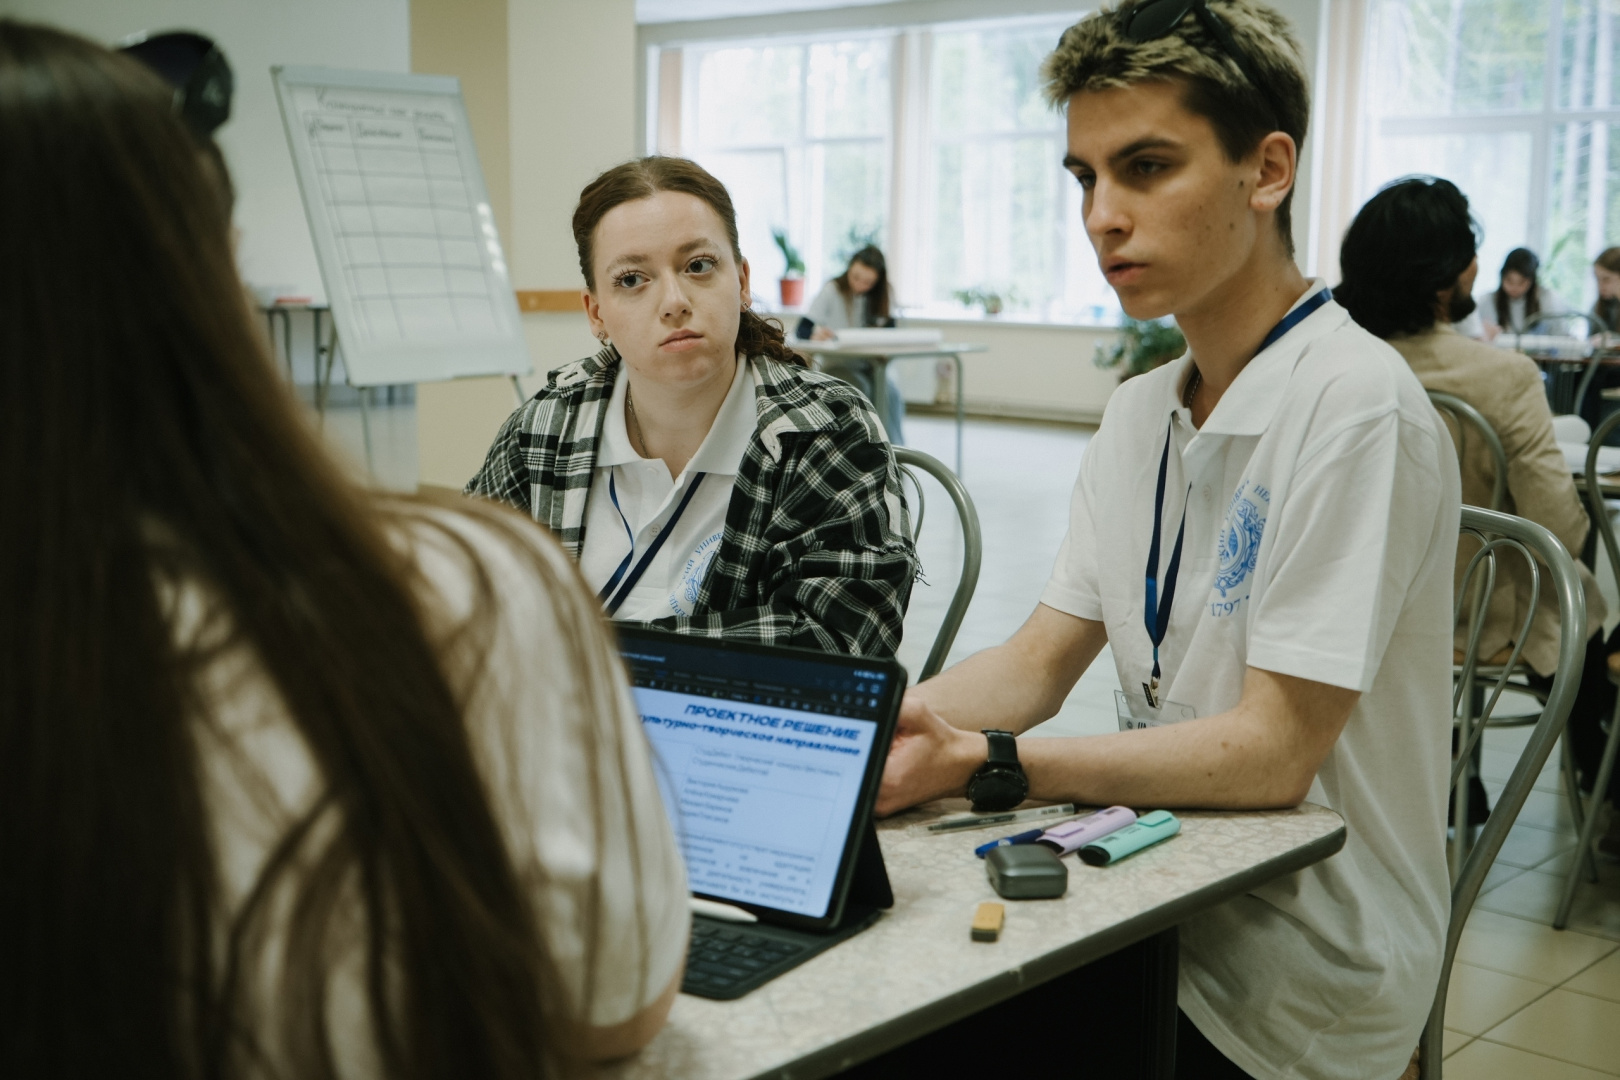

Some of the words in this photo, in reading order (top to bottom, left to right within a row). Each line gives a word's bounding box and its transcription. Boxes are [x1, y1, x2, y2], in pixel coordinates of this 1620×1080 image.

[694, 532, 724, 555] УНИВЕ
[1211, 598, 1241, 617] 1797
[637, 713, 774, 742] ультурно-творческое
[684, 703, 778, 728] ПРОЕКТНОЕ
[781, 719, 861, 741] РЕШЕНИЕ
